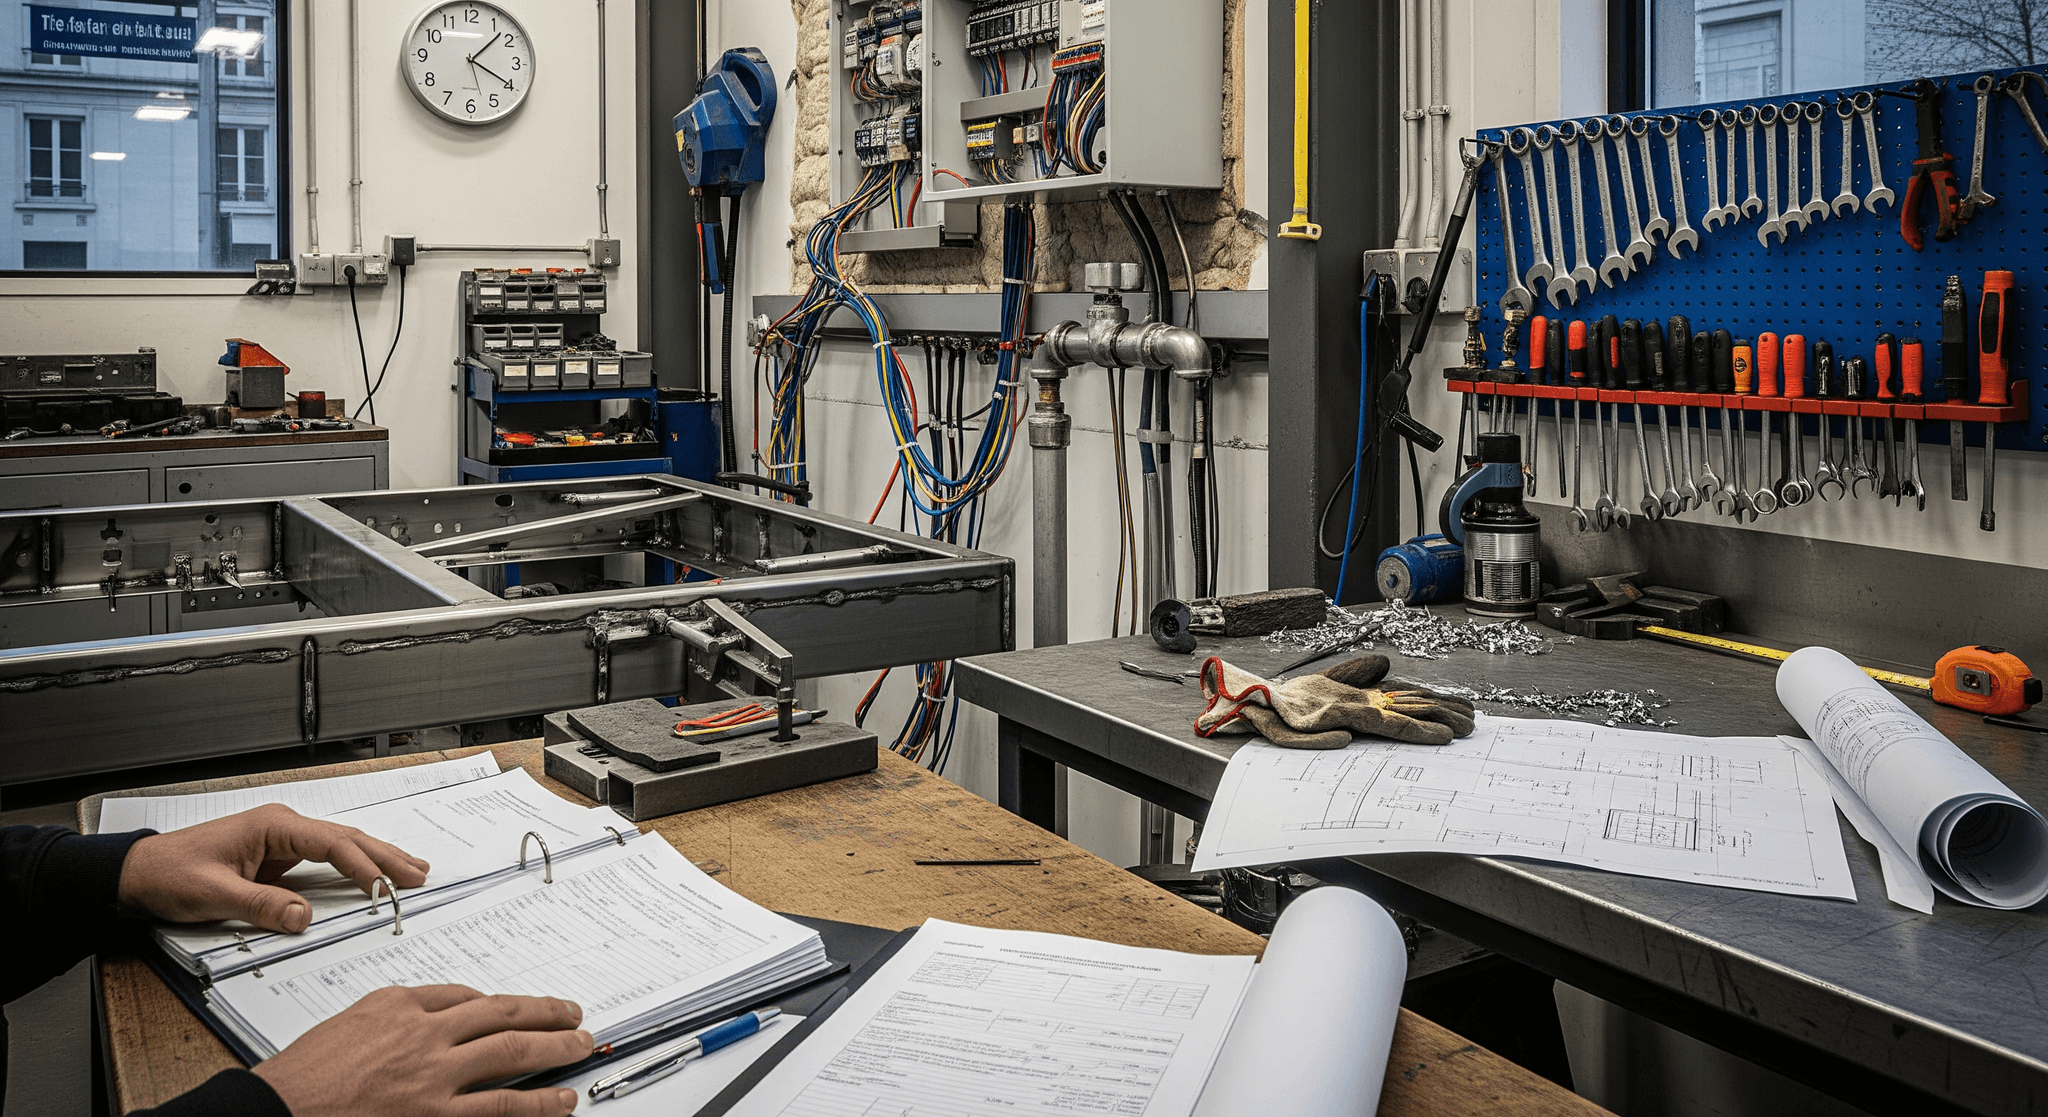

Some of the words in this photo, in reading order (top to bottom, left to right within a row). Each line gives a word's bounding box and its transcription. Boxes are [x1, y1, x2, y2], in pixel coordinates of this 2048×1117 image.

[442, 14, 455, 29] 11
[464, 9, 479, 24] 12
[491, 17, 496, 32] 1
[425, 28, 442, 44] 10
[504, 33, 515, 48] 2
[417, 48, 428, 62] 9
[511, 56, 521, 71] 3
[424, 72, 435, 87] 8
[503, 78, 514, 91] 4
[442, 90, 453, 105] 7
[488, 93, 499, 108] 5
[465, 98, 476, 114] 6
